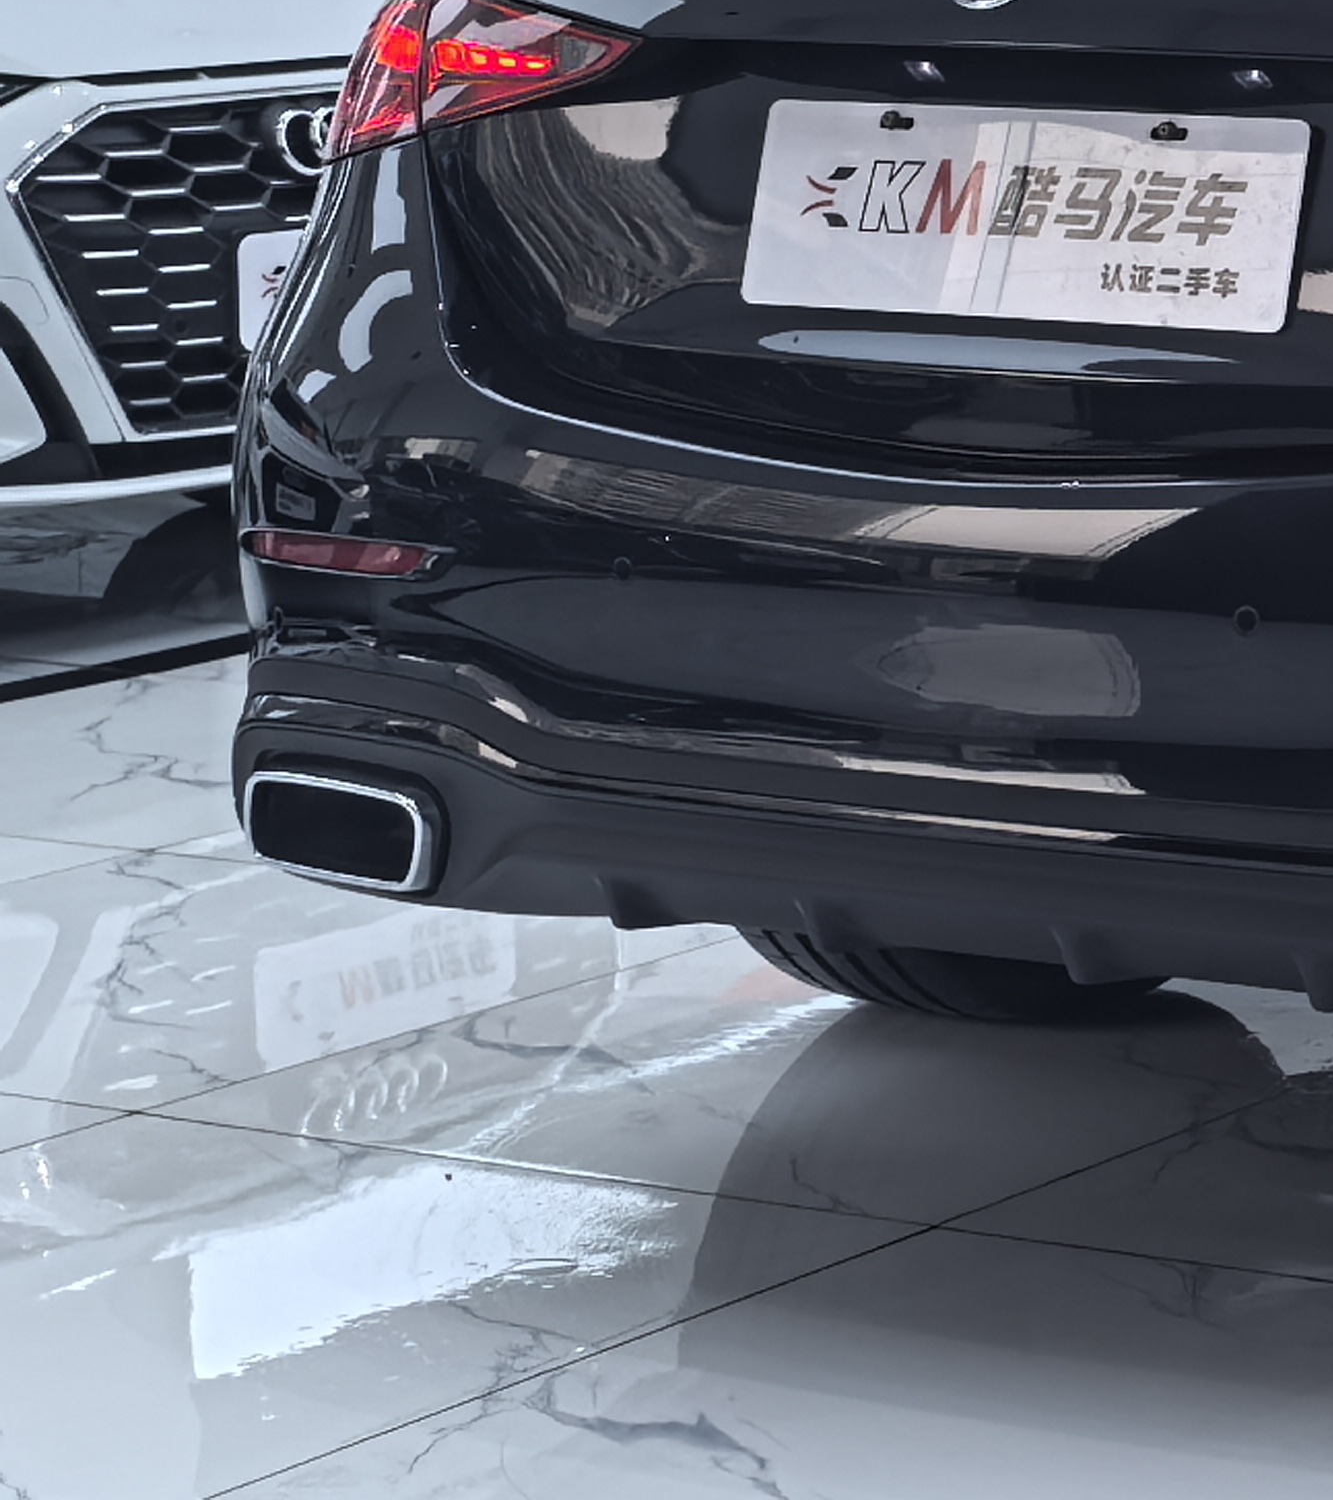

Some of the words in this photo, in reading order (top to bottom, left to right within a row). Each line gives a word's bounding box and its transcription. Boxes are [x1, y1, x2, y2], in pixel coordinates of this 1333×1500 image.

[988, 165, 1249, 246] 酷马汽车
[1101, 262, 1240, 299] 认证二手车
